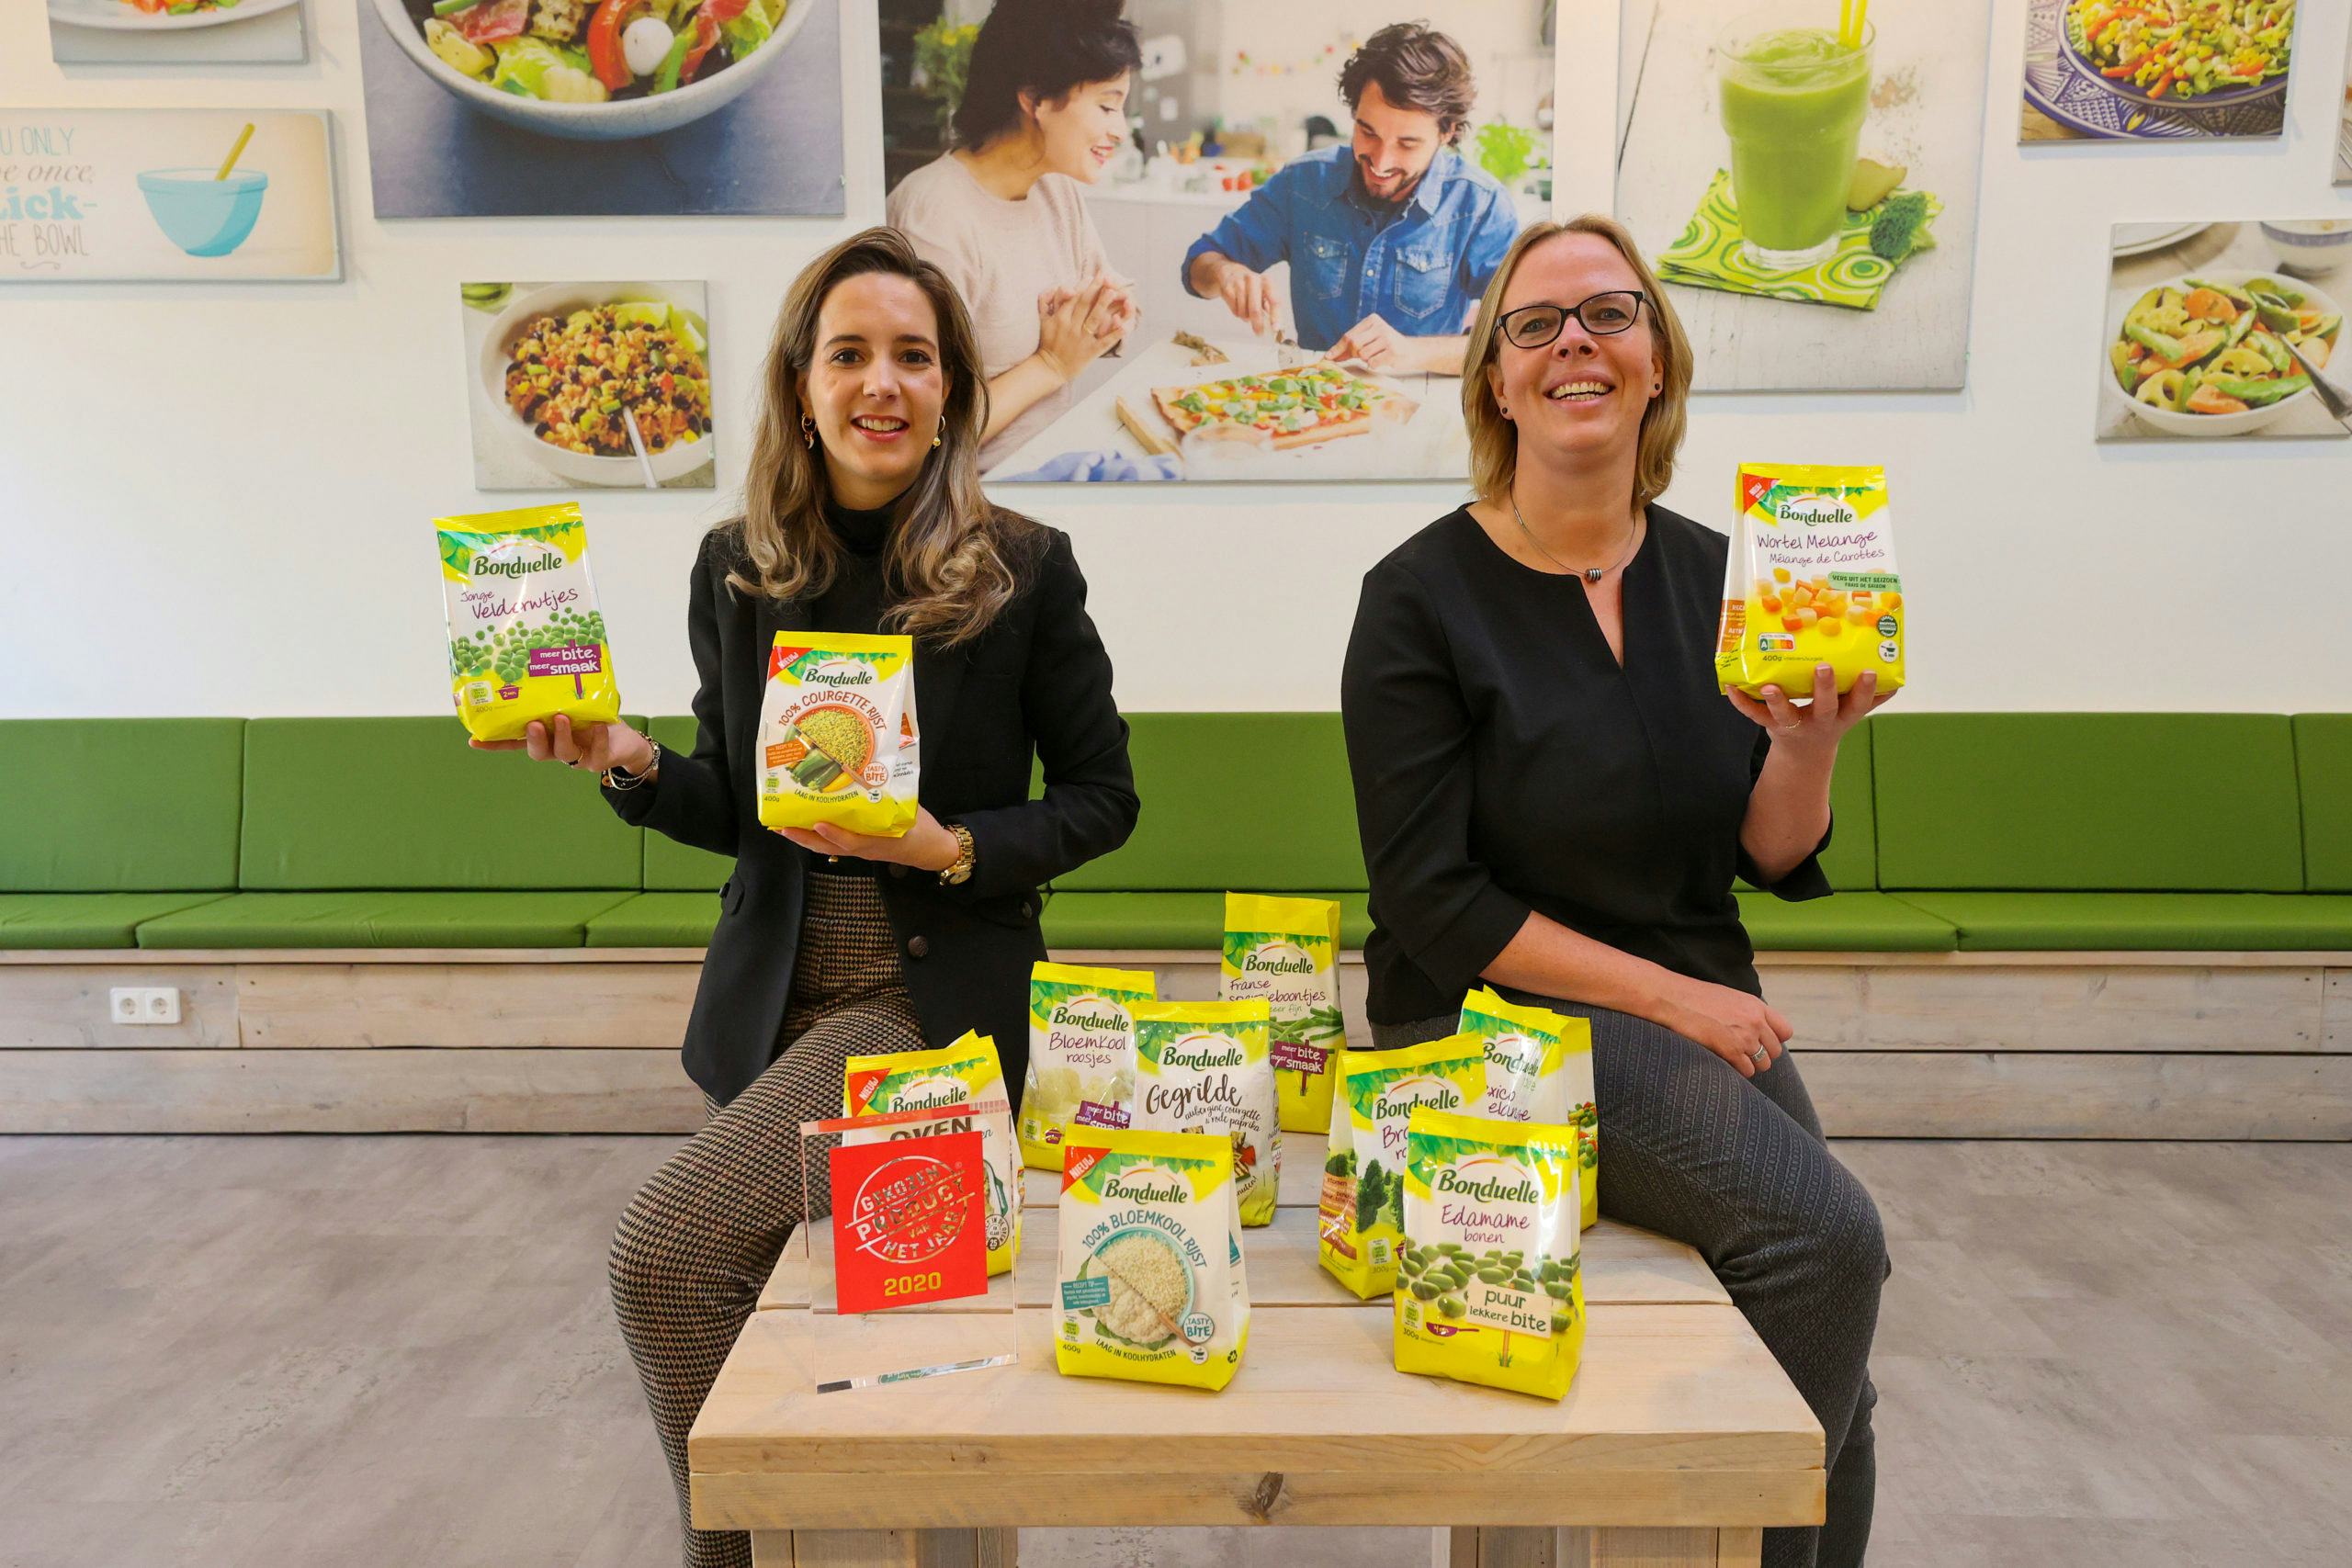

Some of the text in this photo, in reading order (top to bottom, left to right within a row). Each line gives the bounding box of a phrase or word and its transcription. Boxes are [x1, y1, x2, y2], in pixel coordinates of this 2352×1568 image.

[20, 126, 74, 156] ONLY
[33, 223, 90, 256] BOWL
[1780, 504, 1853, 526] Bonduelle
[1758, 530, 1878, 549] Wortel Melange
[474, 553, 562, 579] Bonduelle
[1770, 548, 1884, 568] Mélange de Carottes
[460, 590, 494, 604] Jonge
[550, 660, 598, 675] smaak
[805, 668, 873, 688] Bonduelle
[778, 691, 888, 730] 100% COURGETTE RIJST
[865, 773, 886, 782] BITE
[1245, 954, 1313, 976] Bonduelle
[1229, 977, 1272, 990] Franse
[1053, 1007, 1129, 1032] Bonduelle
[1067, 1052, 1112, 1067] roosjes
[1163, 1047, 1242, 1071] Bonduelle
[1286, 1059, 1323, 1073] smaak
[858, 1077, 879, 1100] NIEUW
[892, 1087, 967, 1112] Bonduelle
[1147, 1074, 1242, 1119] Gegrilde
[890, 1116, 971, 1142] OVEN
[1229, 1117, 1261, 1132] paprika
[1069, 1155, 1094, 1179] NIEUW
[861, 1164, 940, 1212] GEKOZEN
[1105, 1179, 1188, 1204] Bonduelle
[1438, 1169, 1539, 1204] Bonduelle
[856, 1178, 965, 1241] PRODUCT
[1442, 1204, 1531, 1230] Edamame
[882, 1240, 919, 1259] HET
[926, 1211, 959, 1253] JAAR
[1082, 1210, 1208, 1268] 100% BLOEMKOOL RIJST
[1464, 1228, 1505, 1244] bonen
[884, 1271, 942, 1296] 2020
[1485, 1289, 1526, 1309] puur
[1186, 1325, 1210, 1337] BITE
[1469, 1305, 1546, 1333] lekkere bite
[1063, 1344, 1081, 1354] 400g
[1096, 1338, 1176, 1362] LAAG IN KOOLHYDRATEN
